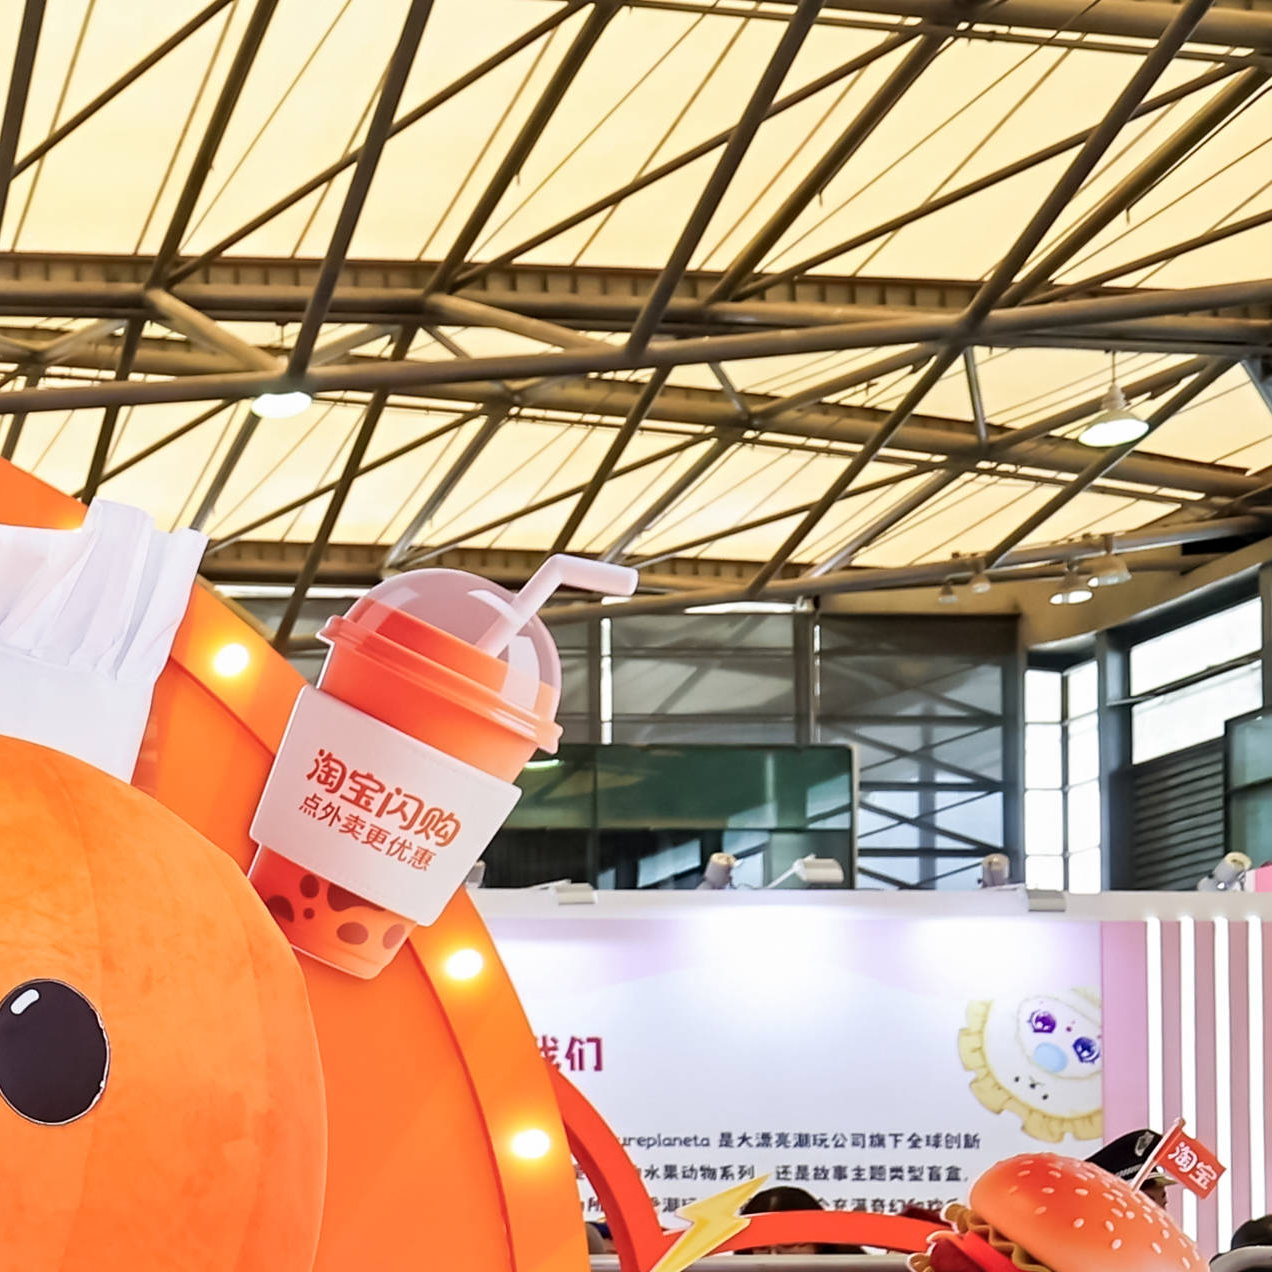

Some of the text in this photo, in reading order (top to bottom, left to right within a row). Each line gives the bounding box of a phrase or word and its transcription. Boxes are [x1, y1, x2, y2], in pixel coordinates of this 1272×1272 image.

[298, 793, 437, 872] 点外卖更优惠
[306, 748, 461, 848] 淘宝闪购
[1167, 1141, 1218, 1190] 淘宝
